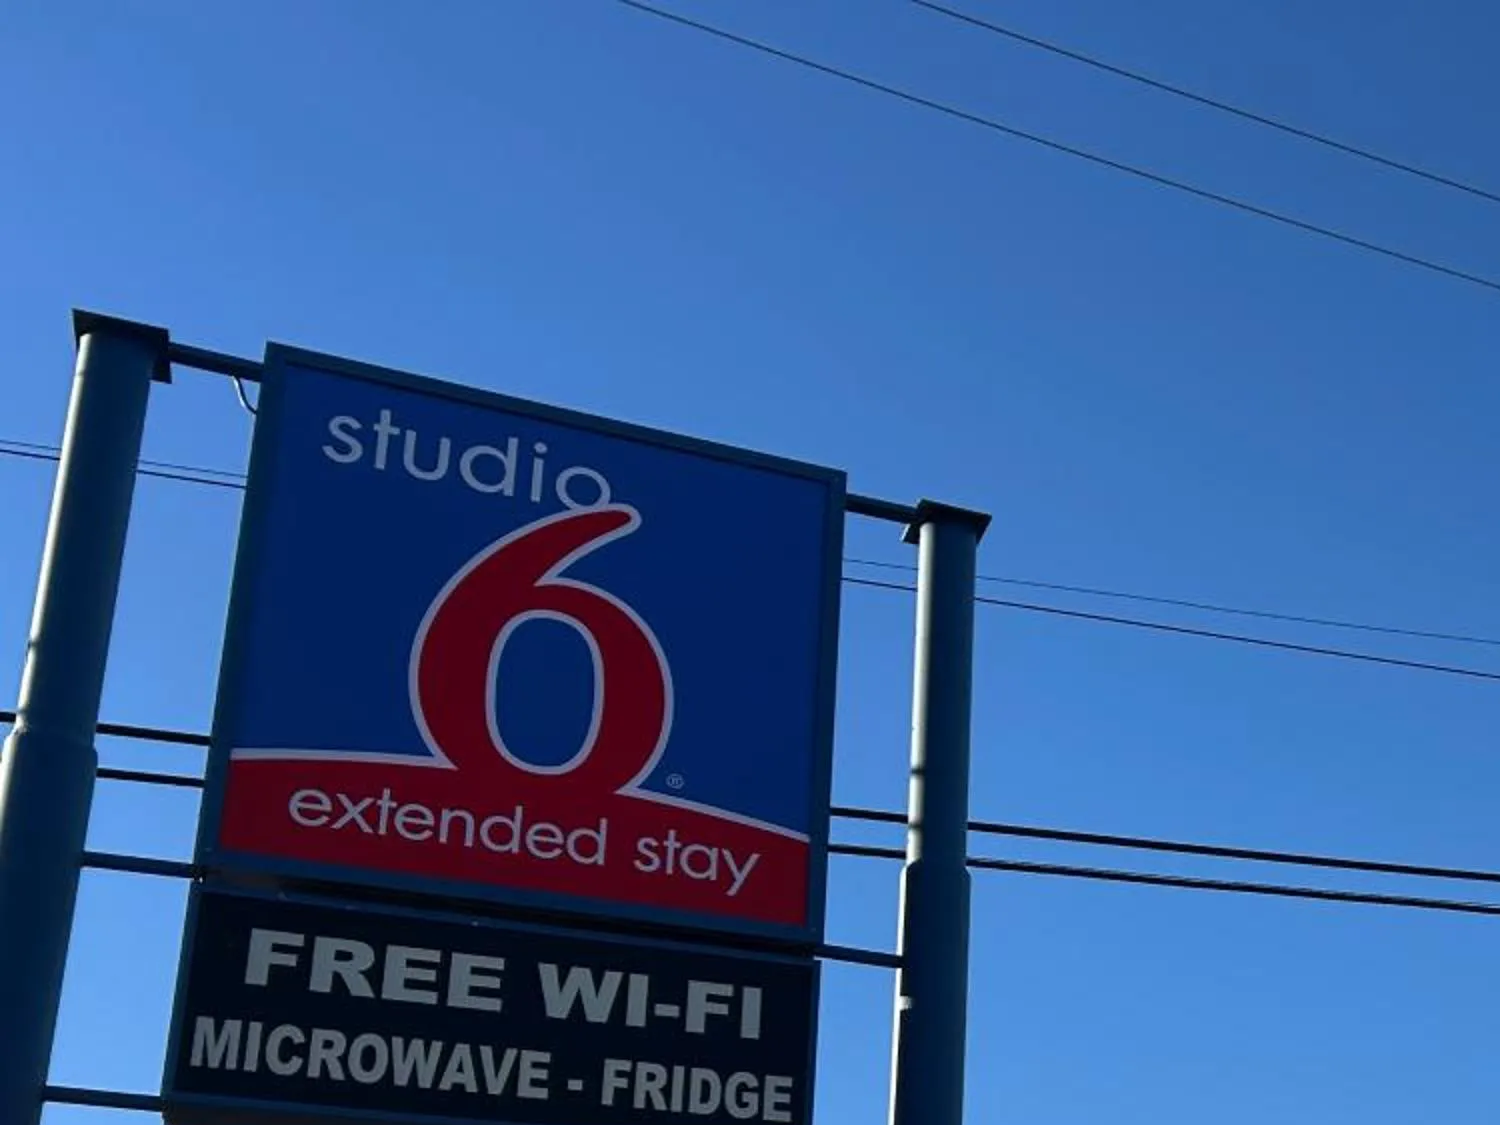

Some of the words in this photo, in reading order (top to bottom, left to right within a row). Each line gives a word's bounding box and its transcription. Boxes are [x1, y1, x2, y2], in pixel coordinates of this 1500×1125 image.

[321, 408, 612, 511] studio
[408, 503, 674, 795] 6
[288, 787, 607, 866] extended
[633, 828, 760, 896] stay
[244, 928, 505, 1012] FREE
[538, 963, 762, 1040] WI-FI
[190, 1016, 552, 1100] MICROWAVE
[600, 1058, 794, 1123] FRIDGE
